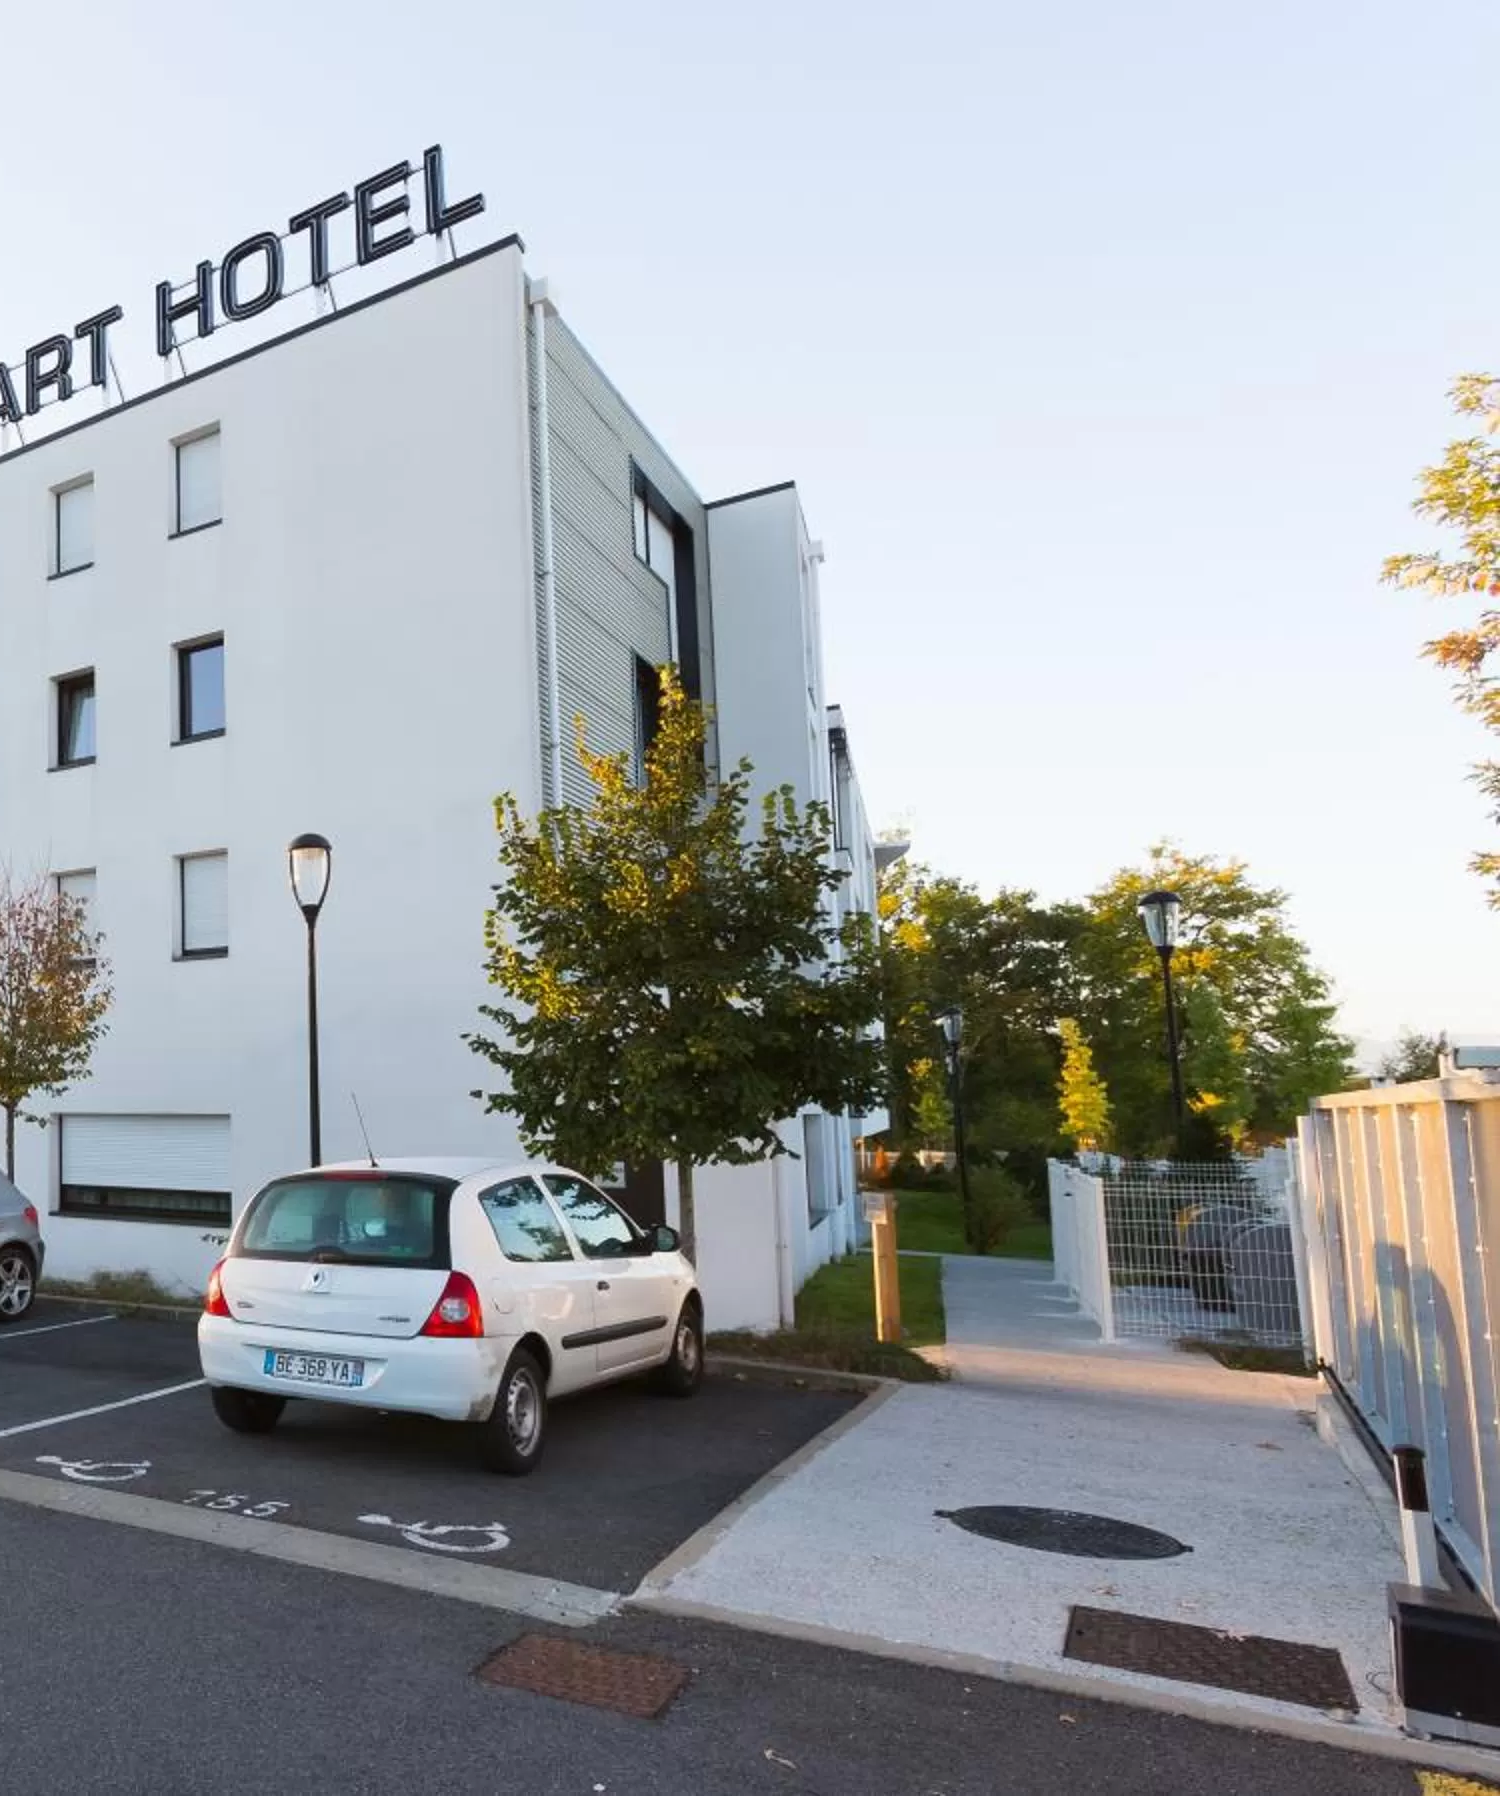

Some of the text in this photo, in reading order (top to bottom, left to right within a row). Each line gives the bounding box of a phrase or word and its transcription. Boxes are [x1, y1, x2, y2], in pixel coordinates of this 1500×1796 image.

[156, 143, 486, 357] HOTEL
[276, 1355, 349, 1380] BE 368 YA
